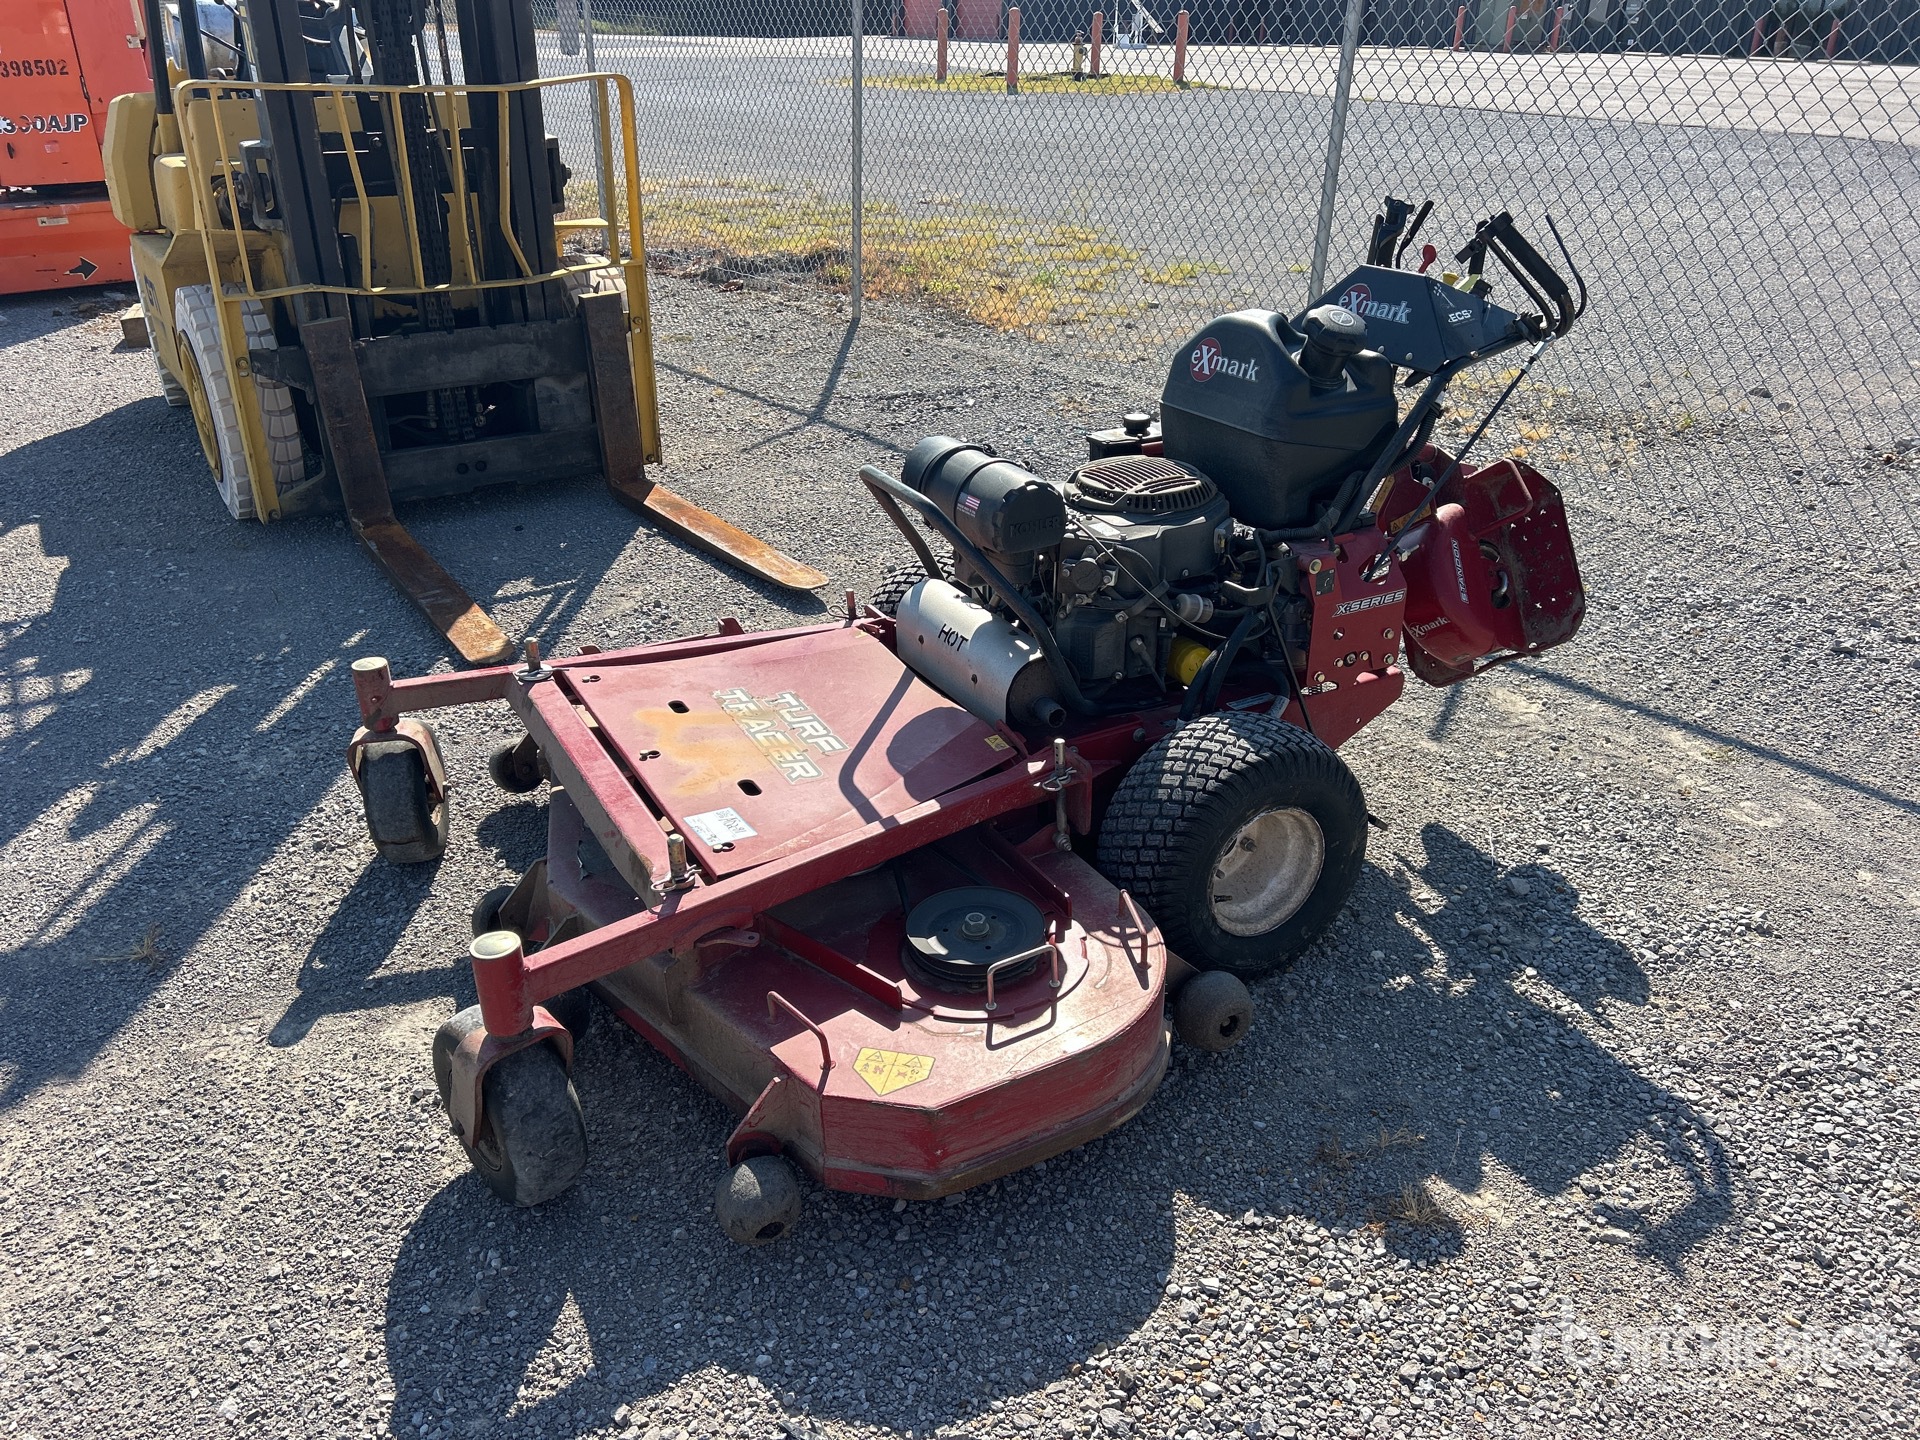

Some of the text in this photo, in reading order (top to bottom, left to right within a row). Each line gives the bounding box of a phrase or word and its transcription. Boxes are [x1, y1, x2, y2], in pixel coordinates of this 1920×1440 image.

[937, 622, 970, 652] HOT
[713, 688, 823, 783] TRACER
[766, 690, 850, 754] TURF
